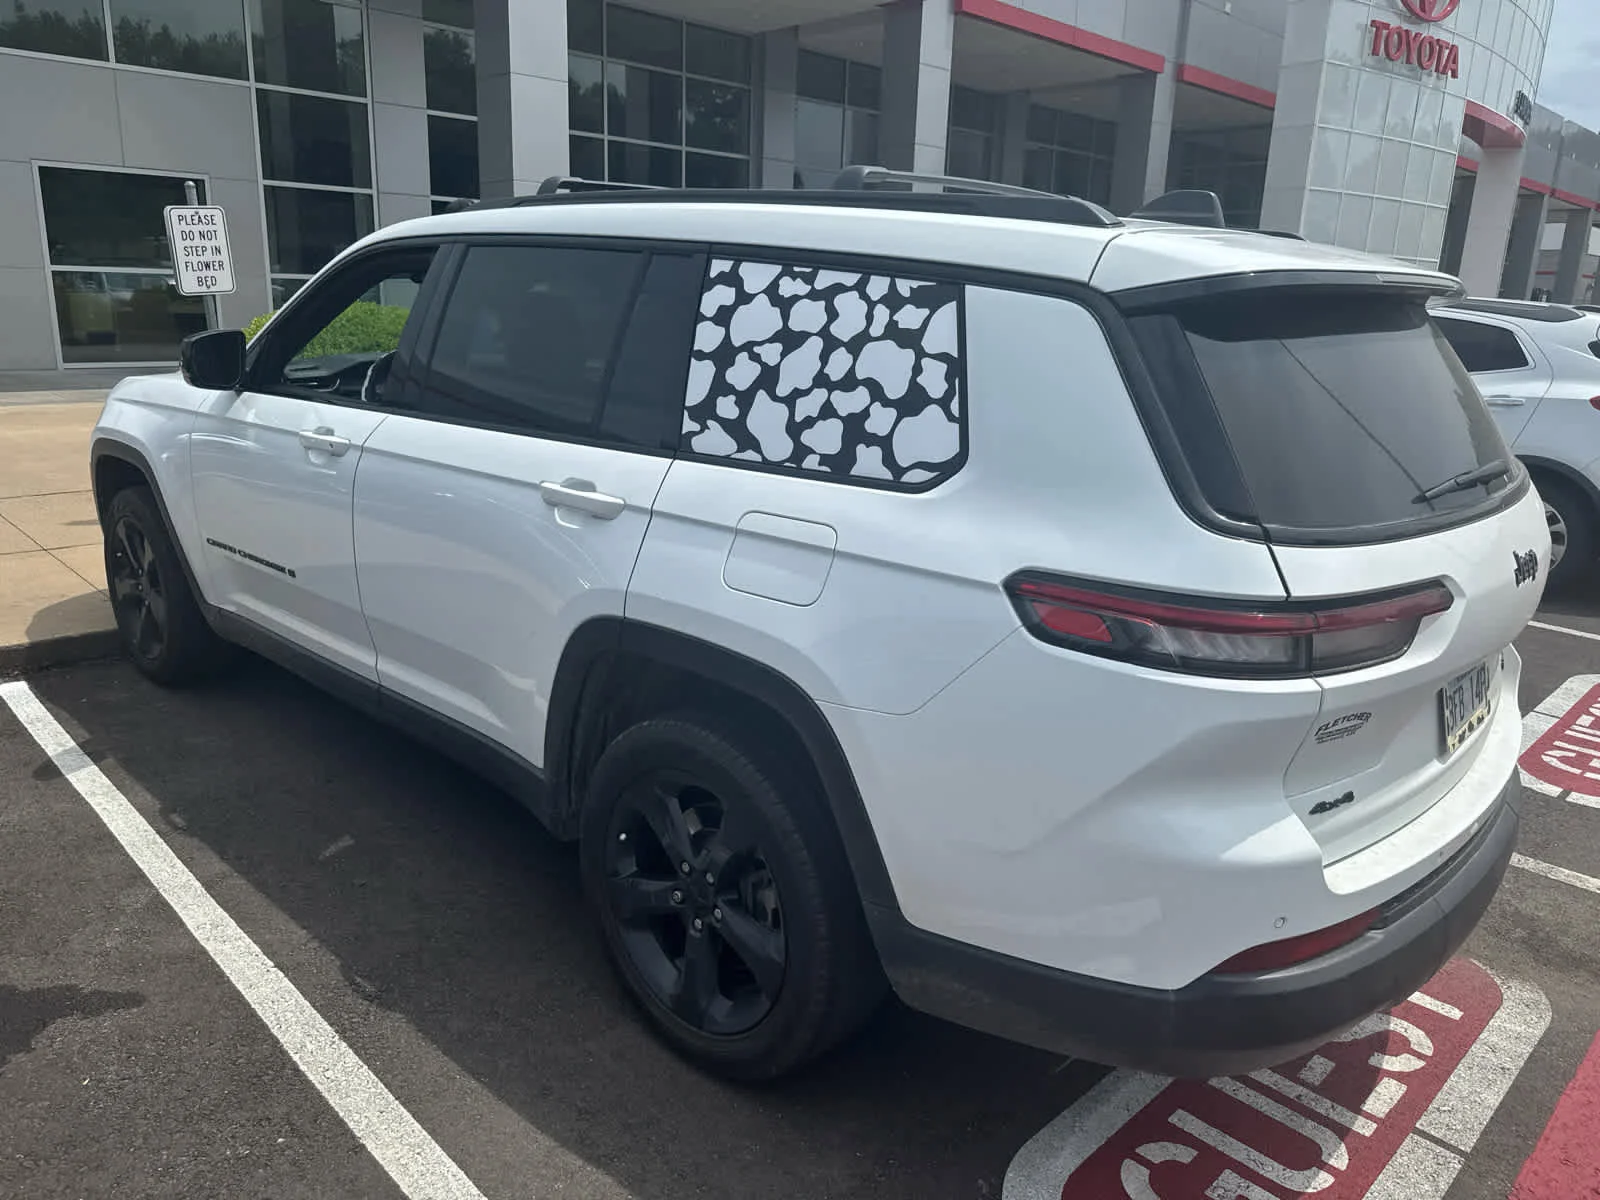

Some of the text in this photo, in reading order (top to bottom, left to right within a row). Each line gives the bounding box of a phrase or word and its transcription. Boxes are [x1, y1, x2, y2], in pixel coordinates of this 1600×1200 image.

[1370, 19, 1459, 79] TOYOTA
[177, 214, 217, 226] PLEASE
[180, 230, 218, 241] DO NOT
[183, 245, 222, 257] STEP IN
[184, 260, 225, 272] FLOWER
[196, 275, 217, 288] BED
[1314, 712, 1372, 736] FLETCHER
